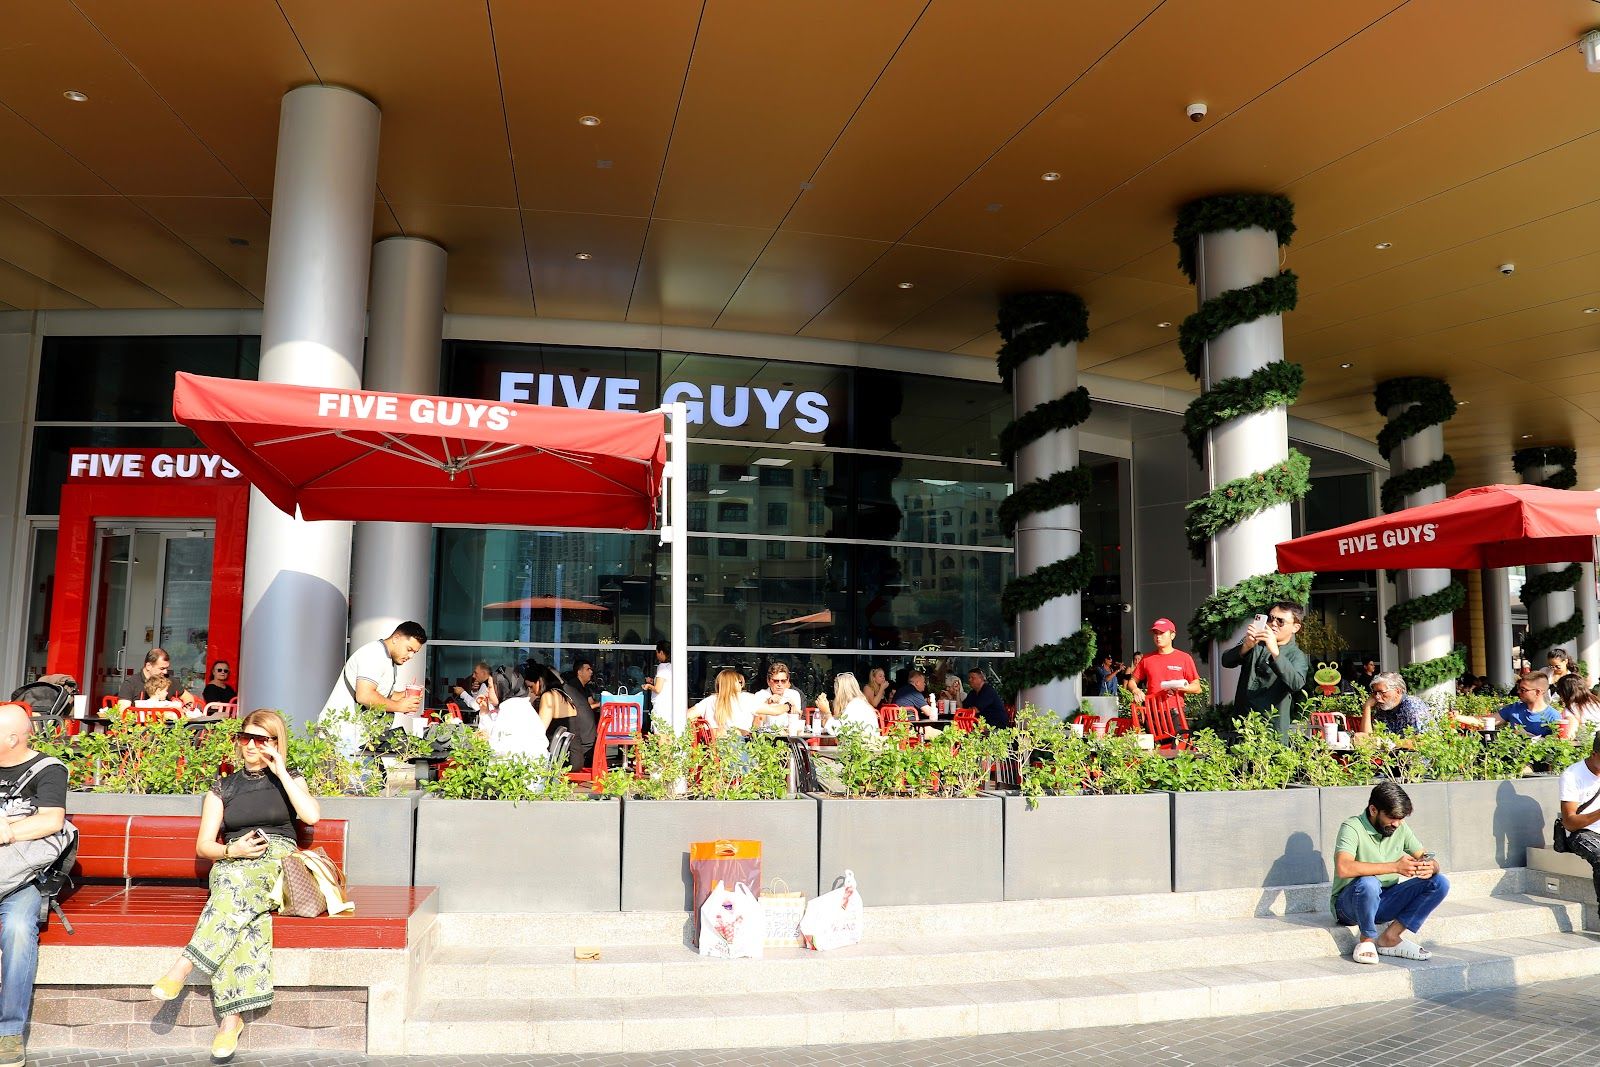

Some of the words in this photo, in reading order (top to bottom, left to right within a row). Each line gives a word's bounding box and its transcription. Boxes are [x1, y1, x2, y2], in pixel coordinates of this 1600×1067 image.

[318, 392, 398, 421] FIVE
[409, 399, 510, 431] GUYS
[500, 371, 640, 413] FIVE
[662, 381, 829, 433] GUYS
[70, 453, 145, 478] FIVE
[151, 453, 242, 478] GUYS
[1338, 533, 1378, 556] FIVE
[1382, 523, 1436, 548] GUYS
